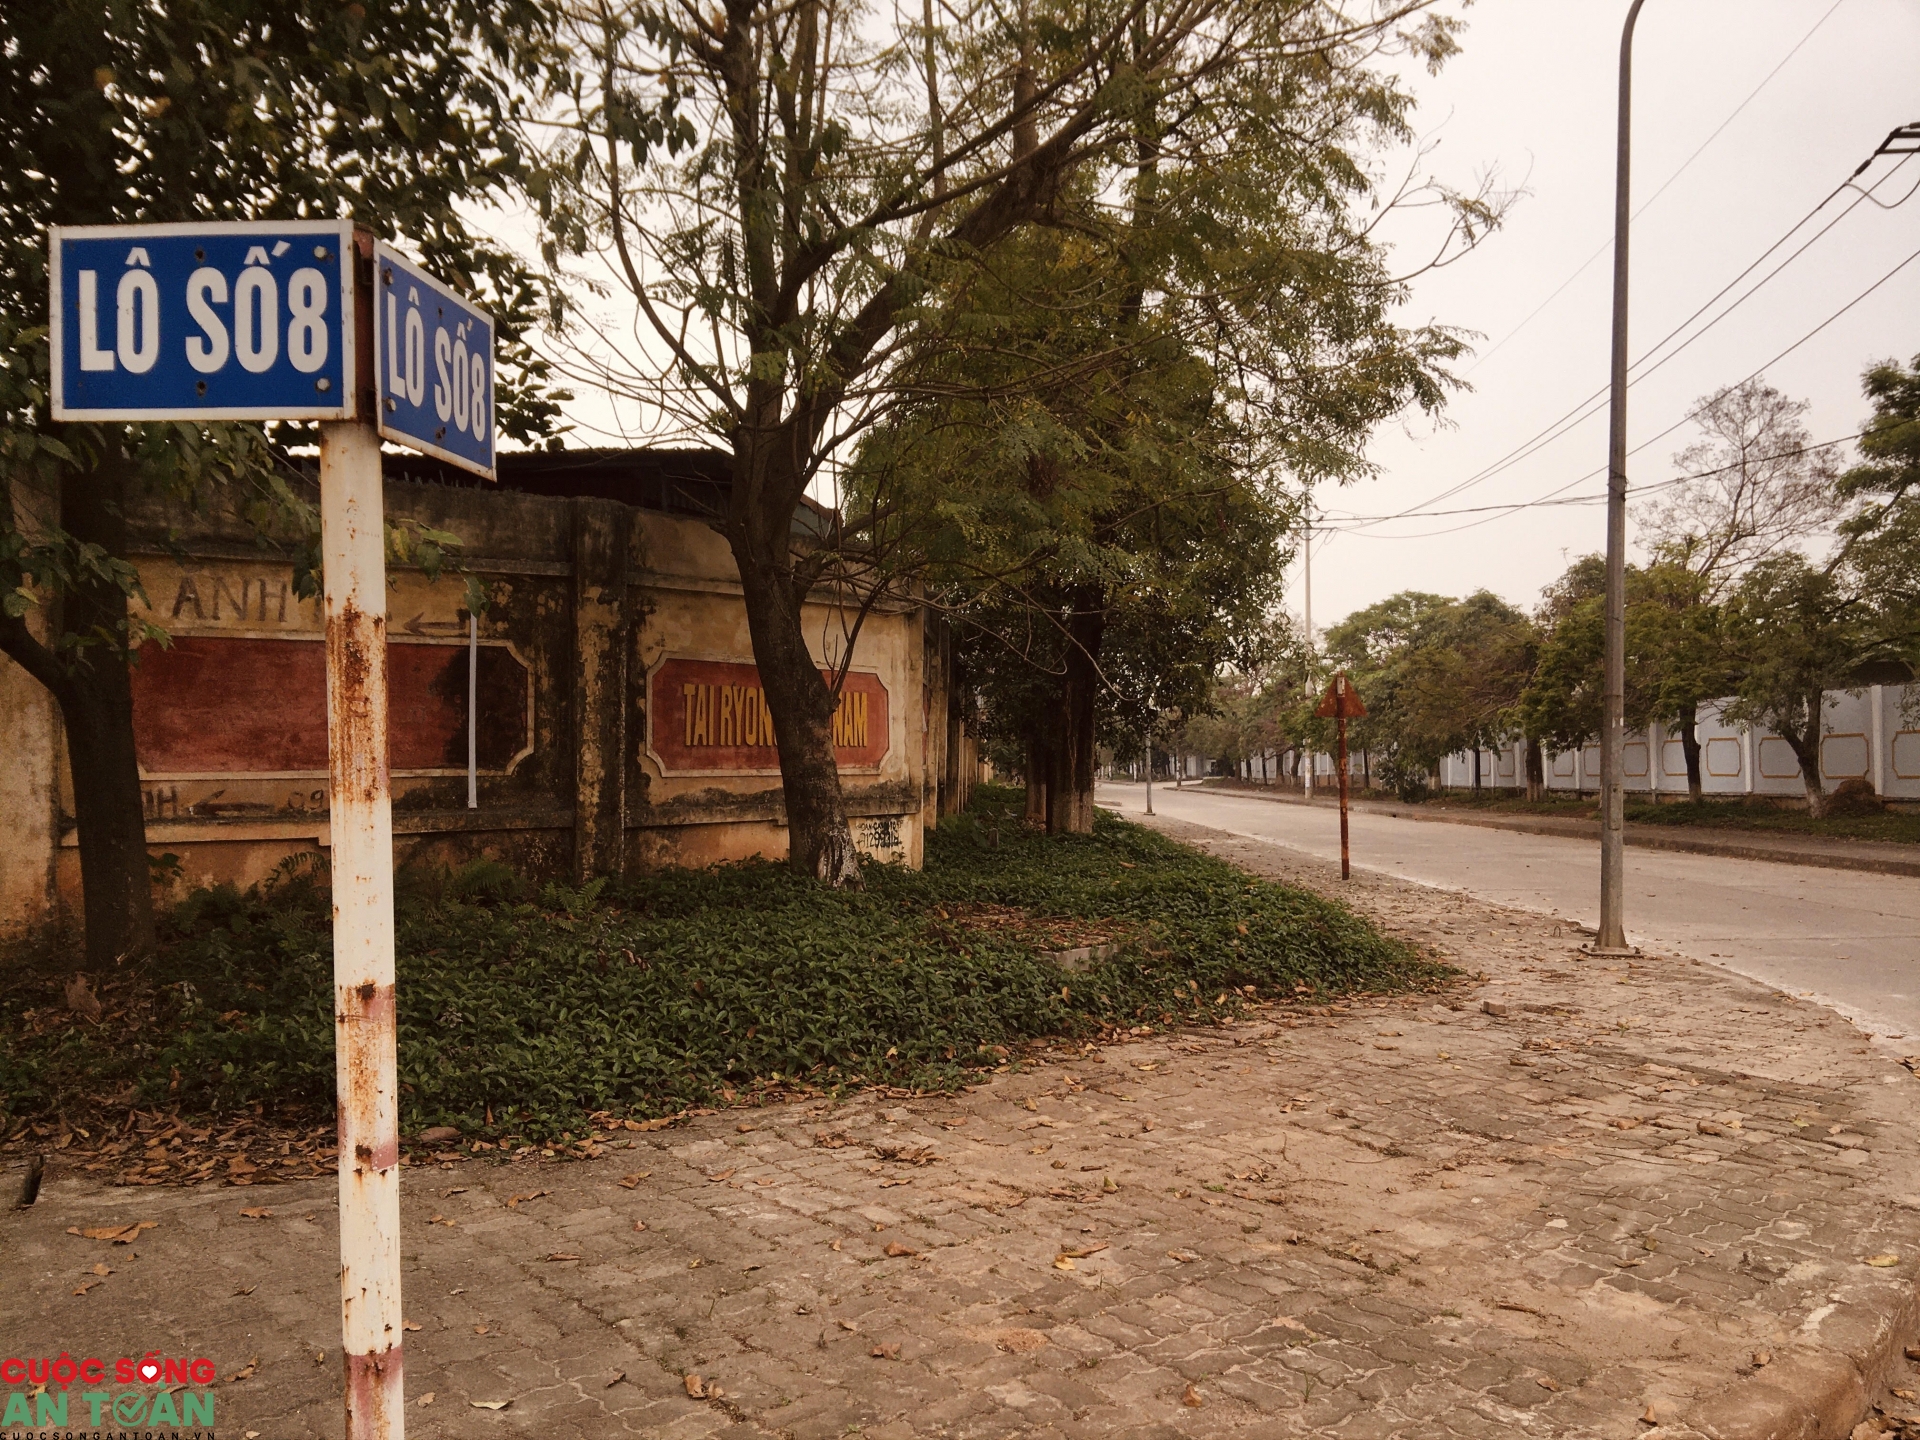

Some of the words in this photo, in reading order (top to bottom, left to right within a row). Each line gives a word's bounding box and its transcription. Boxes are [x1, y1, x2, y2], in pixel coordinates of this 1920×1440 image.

[78, 246, 159, 374] LÔ
[387, 285, 425, 408] LÔ
[683, 683, 715, 746] TAI
[720, 684, 778, 746] RYON
